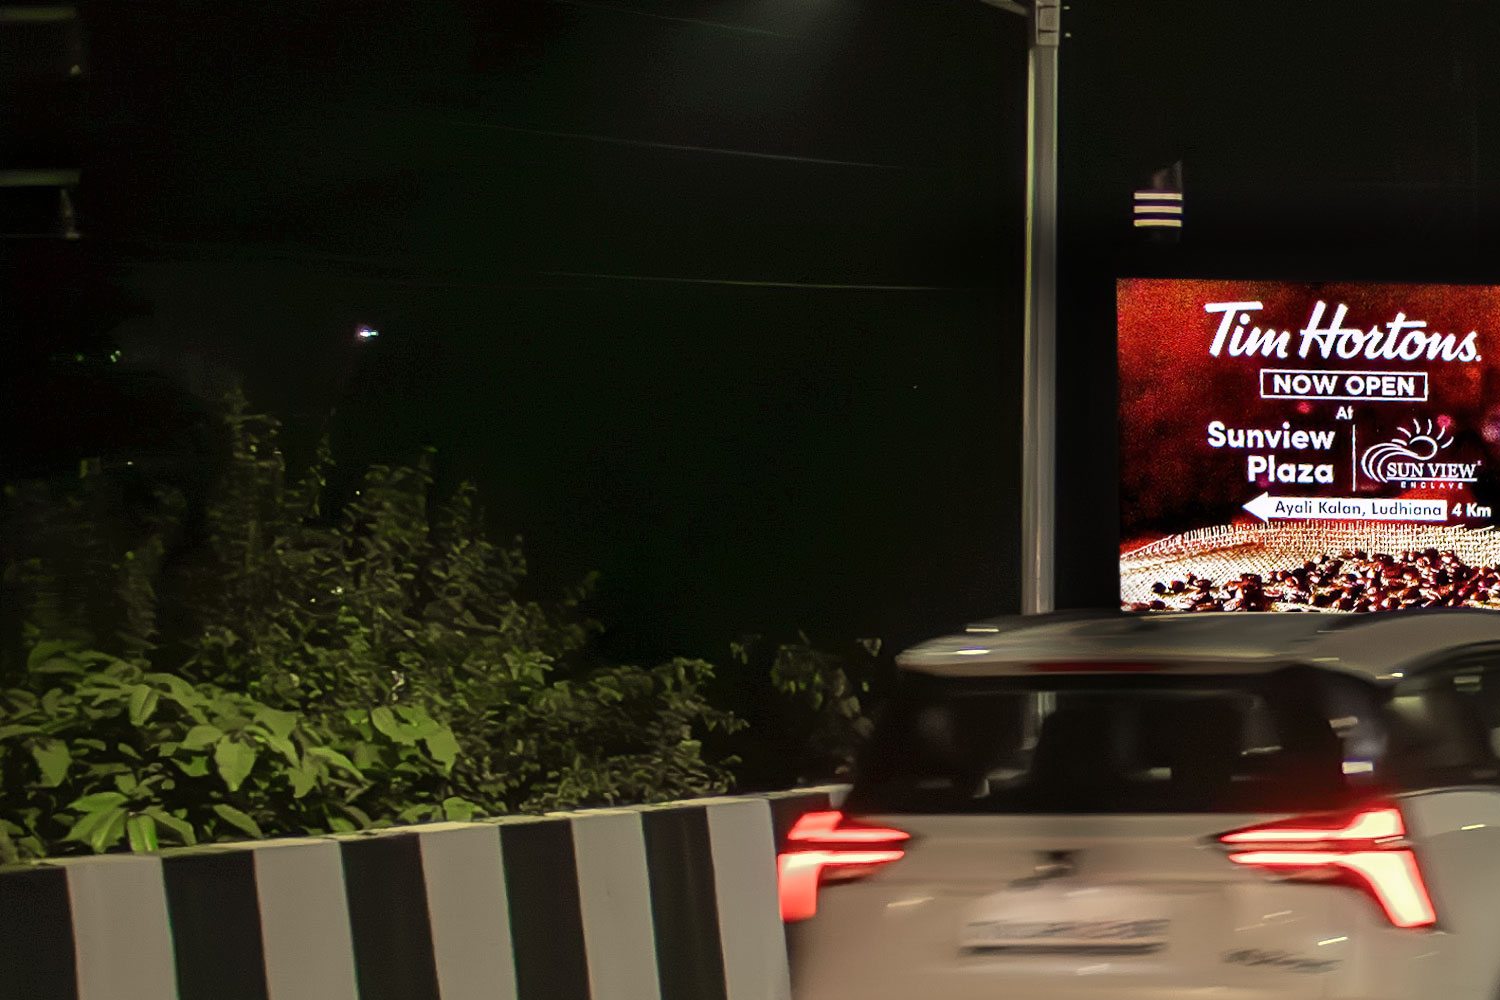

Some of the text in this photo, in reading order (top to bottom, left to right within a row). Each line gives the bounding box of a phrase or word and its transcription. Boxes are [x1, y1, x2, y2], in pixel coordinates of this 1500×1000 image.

[1204, 301, 1290, 359] Tim
[1273, 374, 1415, 397] NOW OPEN
[1335, 406, 1353, 421] At
[1207, 421, 1336, 450] Sunview
[1247, 455, 1334, 484] Plaza
[1386, 462, 1478, 479] SUN VIEW
[1275, 501, 1491, 518] Ayali Kalan, Ludhiana 4 Km
